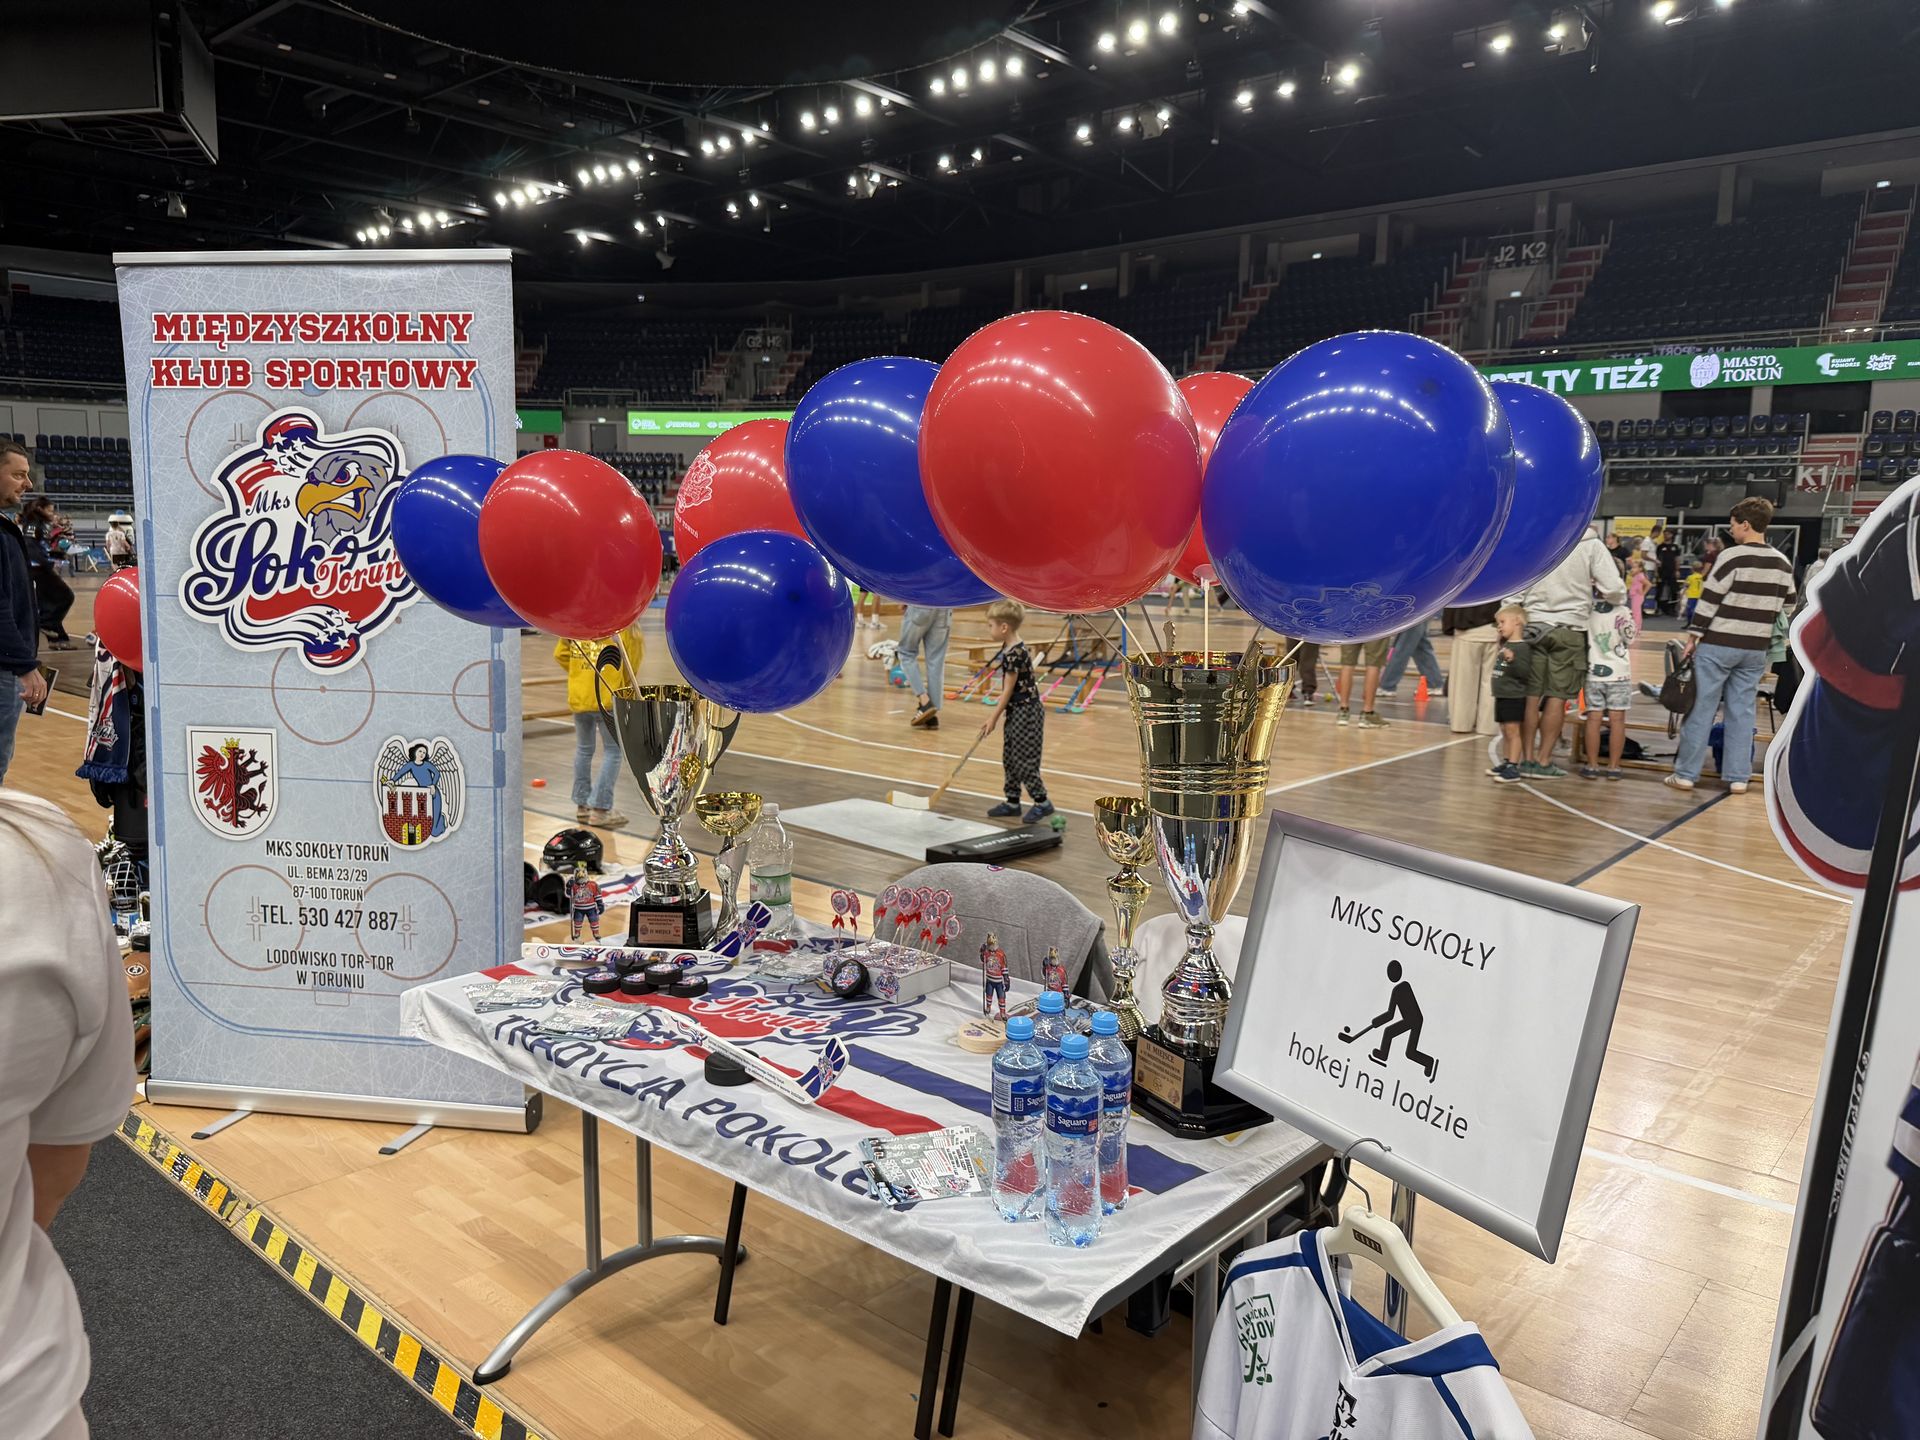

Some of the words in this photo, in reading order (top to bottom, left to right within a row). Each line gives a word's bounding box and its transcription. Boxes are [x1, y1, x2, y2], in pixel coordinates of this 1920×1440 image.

[1494, 245, 1516, 263] J2
[1521, 241, 1547, 260] K2
[152, 312, 474, 351] MIĘDZYSZKOLNY
[1722, 363, 1784, 382] TORUŃ
[1723, 355, 1777, 368] MIASTO
[151, 358, 252, 389] KLUB
[265, 358, 477, 390] SPORTOWY
[1542, 368, 1580, 391] TY
[1590, 358, 1663, 390] TEŻ?
[1796, 464, 1829, 487] K1
[246, 489, 291, 516] Mks
[314, 550, 404, 595] Toruń
[266, 841, 293, 857] MKS
[295, 842, 343, 860] SOKOŁY
[347, 842, 389, 862] TORUŃ
[287, 865, 304, 879] UL.
[306, 866, 334, 881] BEMA
[337, 867, 368, 882] 23/29
[293, 886, 328, 900] 87-100
[330, 886, 364, 902] TORUŃ
[261, 904, 293, 926] TEL.
[298, 907, 329, 927] 530
[334, 909, 363, 929] 427
[368, 911, 399, 931] 887
[1330, 895, 1383, 934] MKS
[1388, 915, 1496, 971] SOKOŁY
[266, 949, 337, 968] LODOWISKO
[341, 953, 395, 971] TOR-TOR
[296, 971, 307, 985] W
[312, 971, 365, 989] TORUNIU
[1153, 1045, 1174, 1064] MIEJSCE
[1288, 1031, 1351, 1088] hokej
[1355, 1070, 1384, 1100] na
[1391, 1080, 1469, 1139] lodzie
[1057, 1115, 1088, 1127] Saguaro
[682, 1098, 900, 1207] POKOLE
